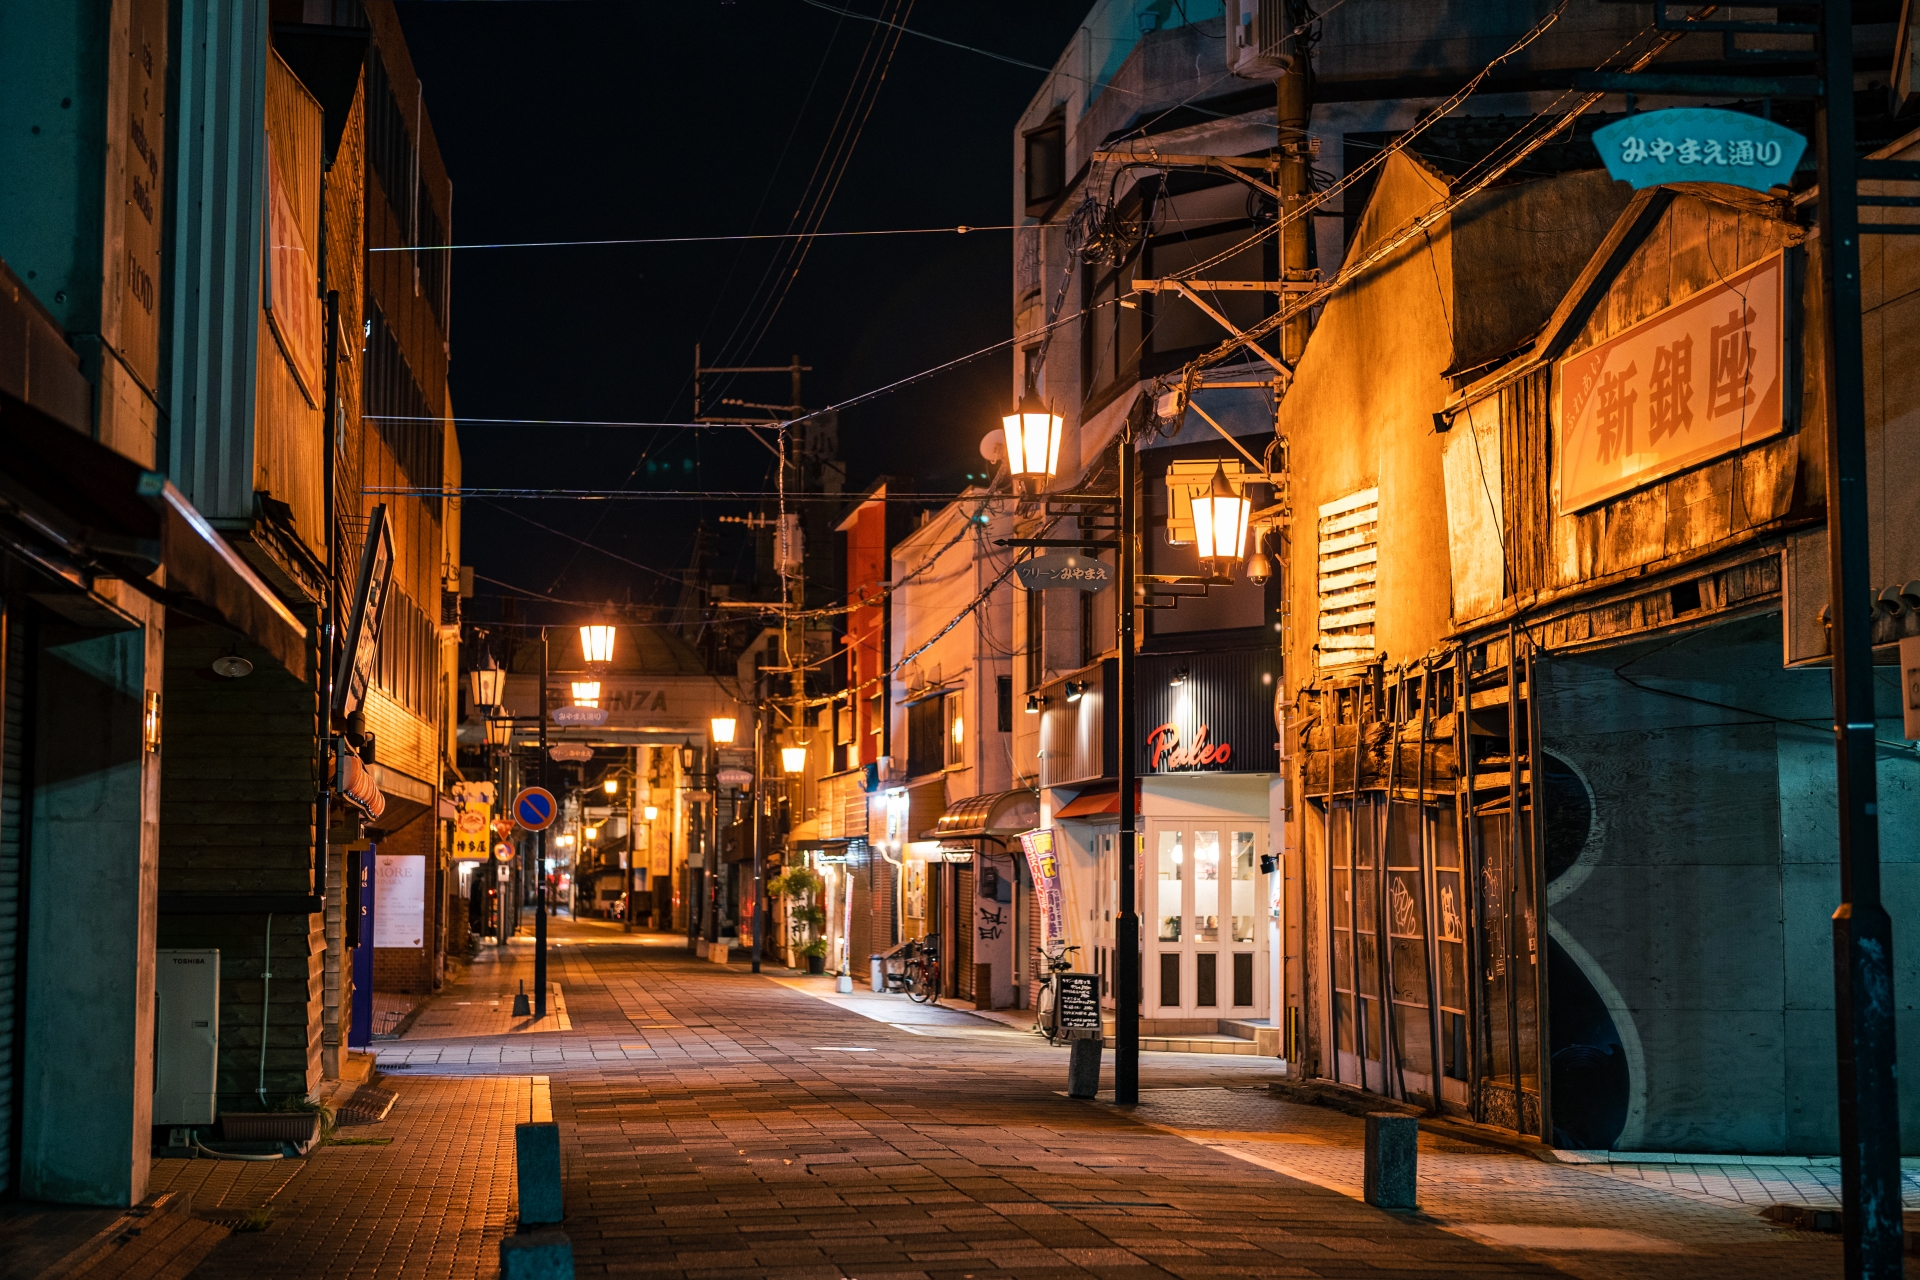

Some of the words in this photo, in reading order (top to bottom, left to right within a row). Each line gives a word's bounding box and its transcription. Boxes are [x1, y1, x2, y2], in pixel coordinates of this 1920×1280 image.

[1619, 135, 1782, 167] みやまえ通り
[128, 249, 154, 316] FLOYD
[1565, 354, 1602, 435] ふれあい
[1595, 305, 1760, 466] 新銀座
[1022, 567, 1108, 581] クリーンみやまえ
[1147, 722, 1231, 768] Paleo
[456, 840, 487, 853] 博多屋
